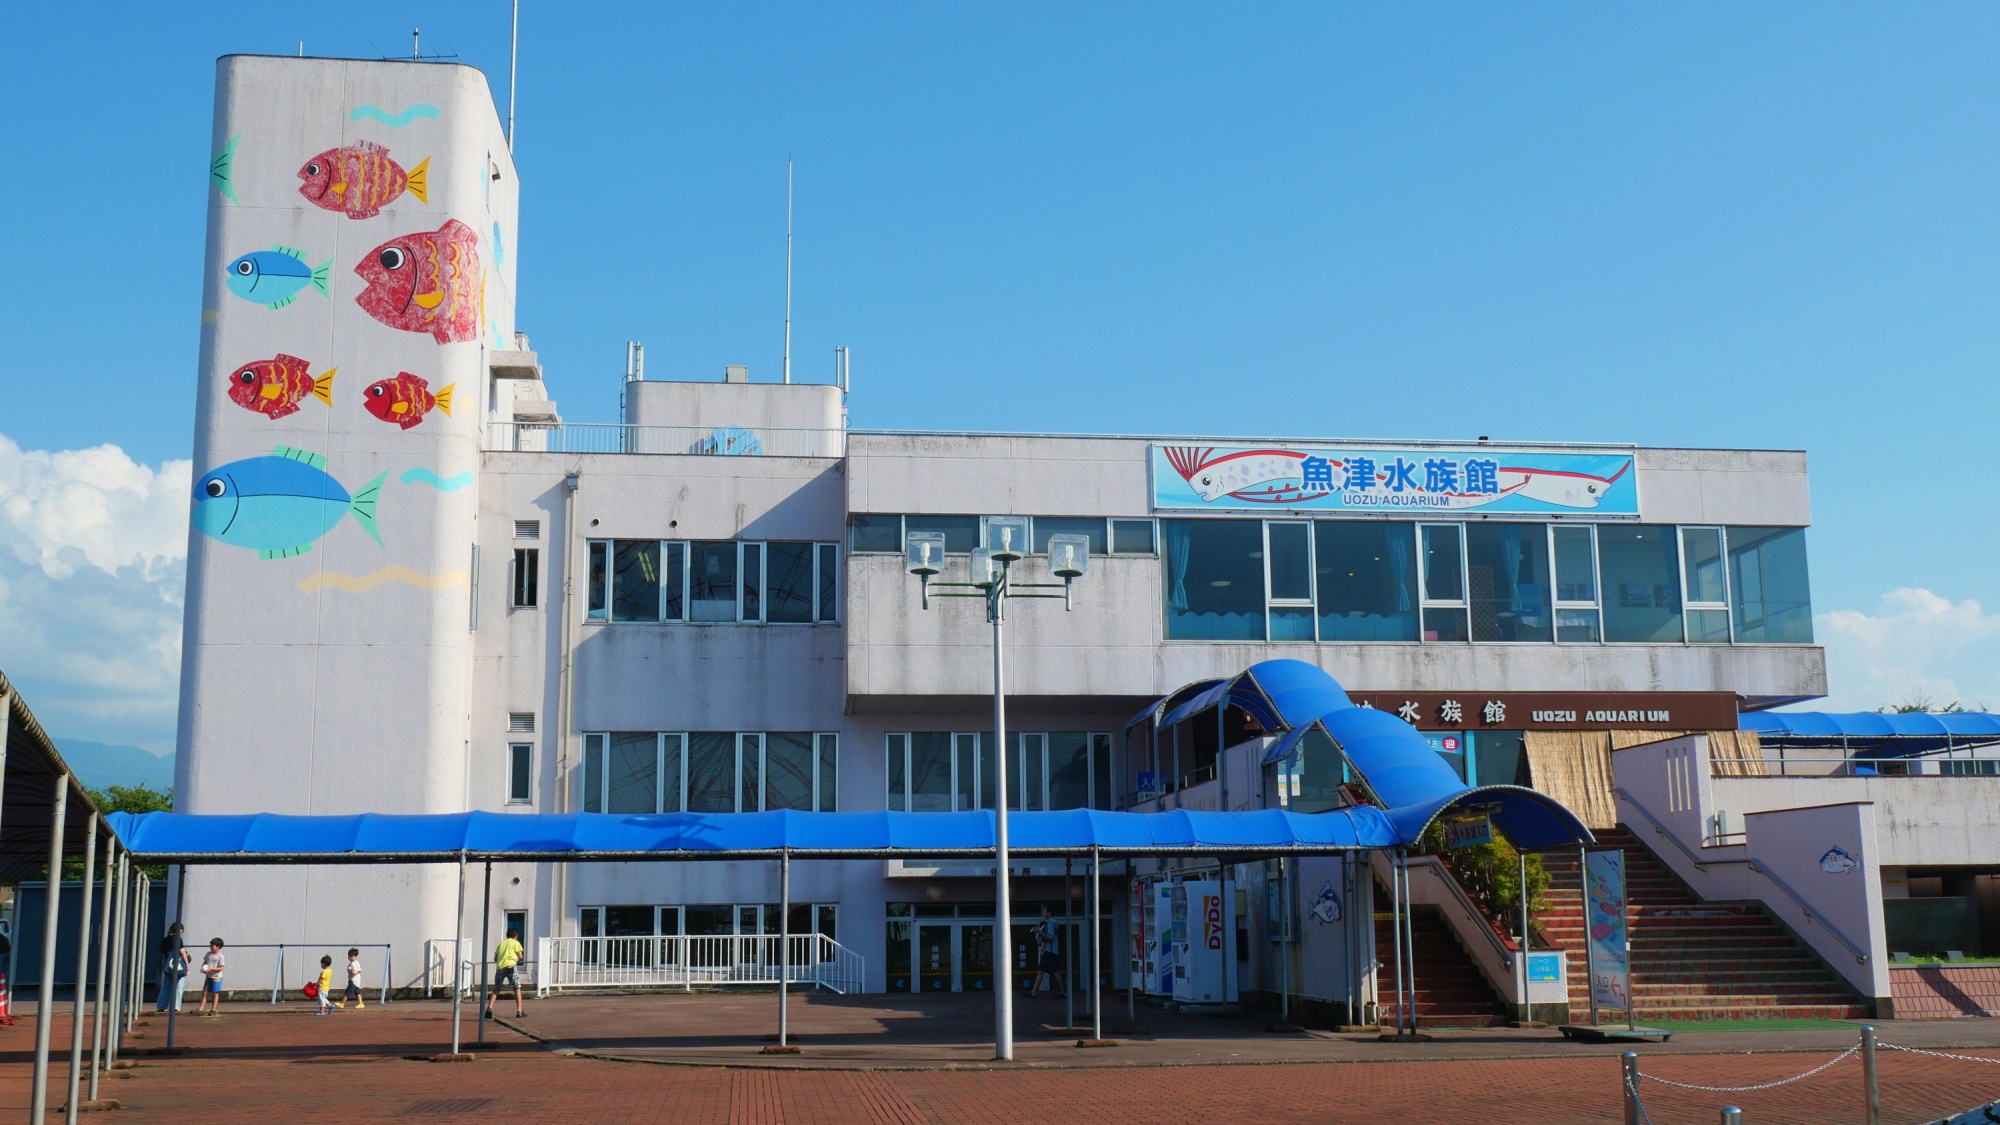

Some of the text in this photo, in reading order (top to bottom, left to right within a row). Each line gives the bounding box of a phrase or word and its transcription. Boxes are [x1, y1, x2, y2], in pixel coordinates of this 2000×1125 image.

[1300, 455, 1499, 495] 魚津水族館
[1343, 494, 1450, 506] UOZU AQUARIUM
[1532, 710, 1670, 722] UOZU AQUARIUM
[1596, 975, 1609, 988] 入口
